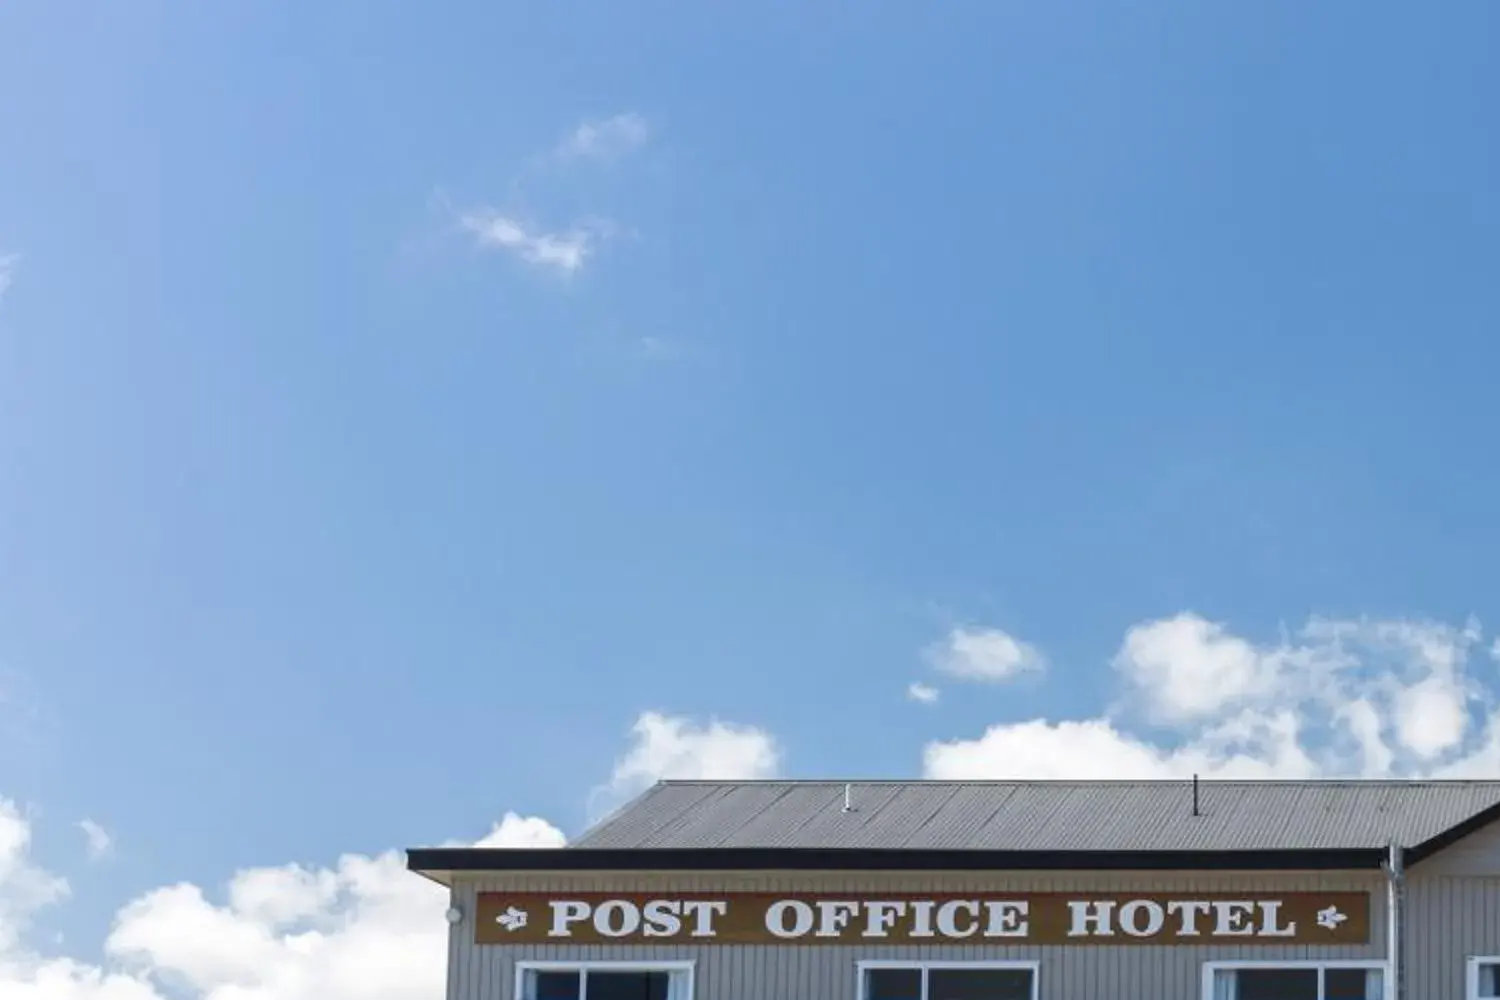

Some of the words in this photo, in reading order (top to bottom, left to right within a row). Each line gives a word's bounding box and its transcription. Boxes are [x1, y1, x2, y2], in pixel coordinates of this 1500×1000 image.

[547, 899, 727, 937] POST
[764, 899, 1029, 938] OFFICE
[1067, 899, 1296, 937] HOTEL
